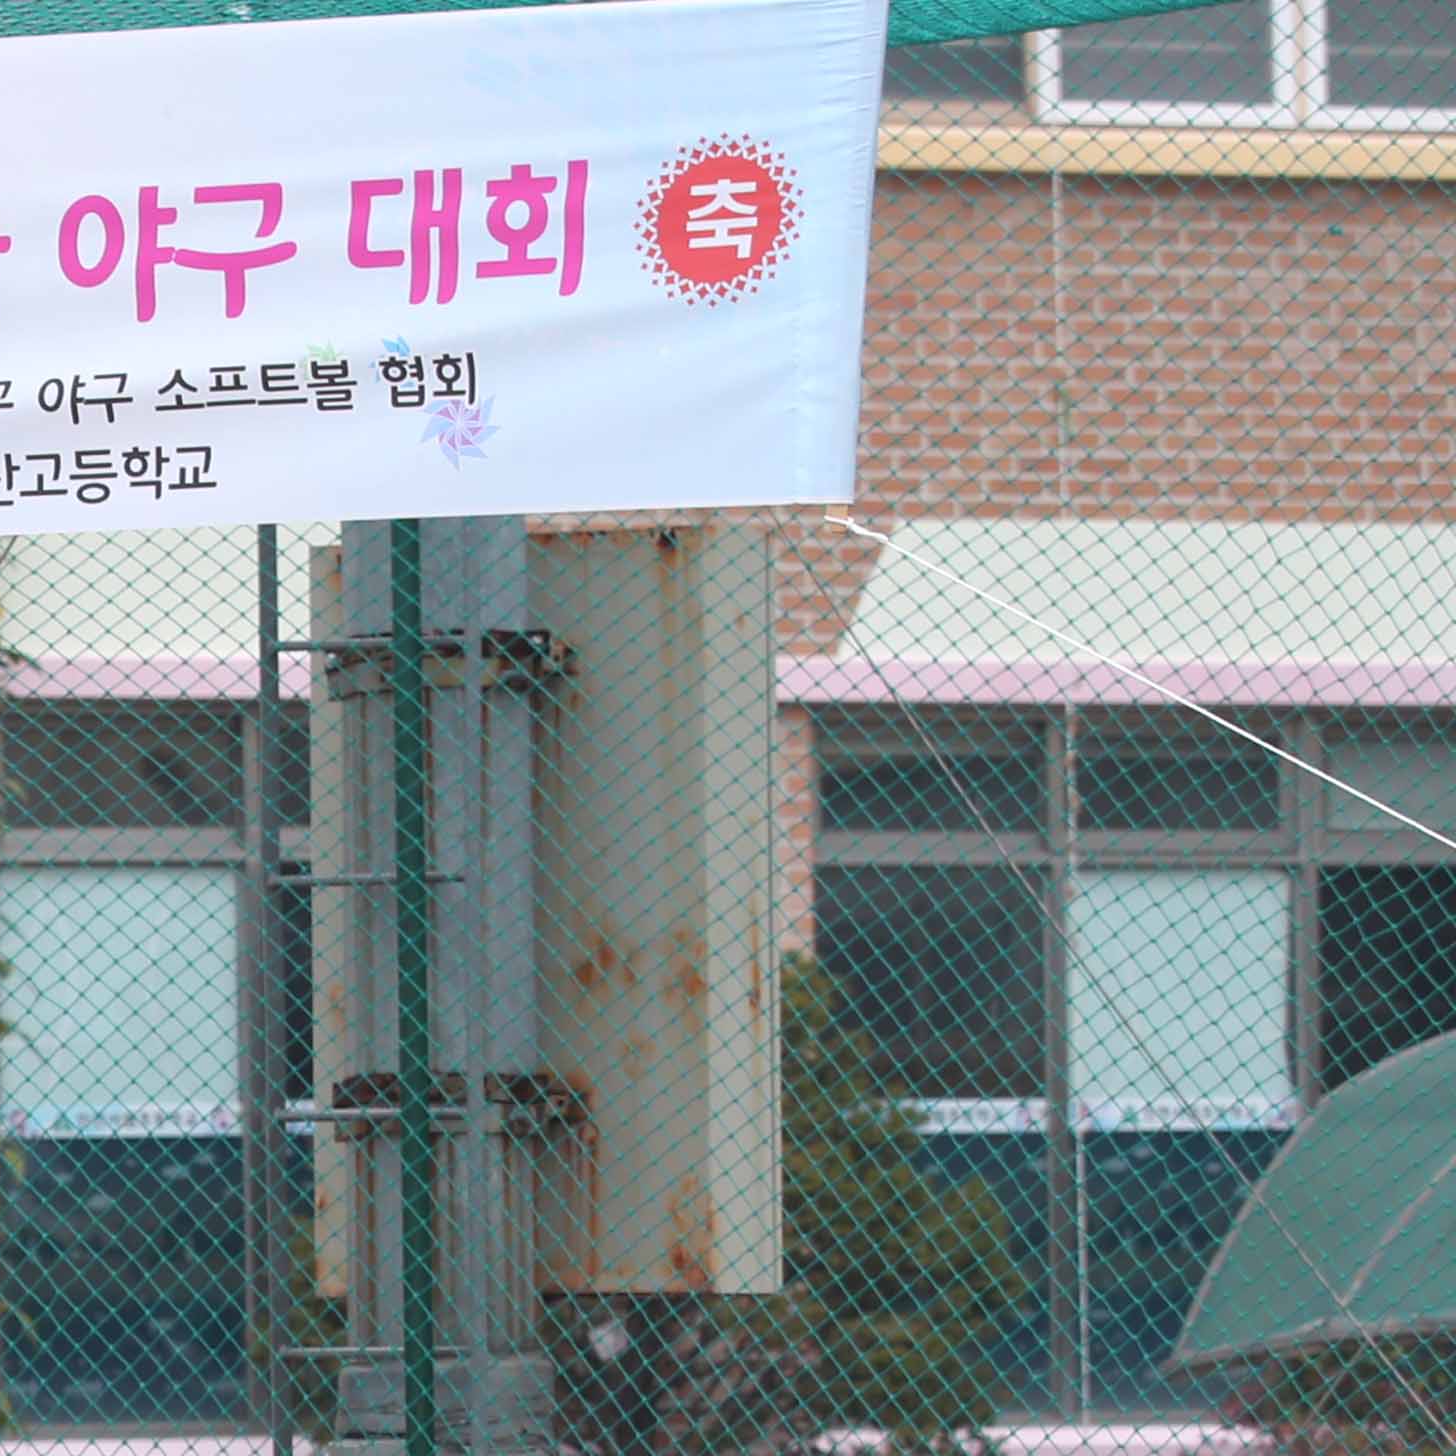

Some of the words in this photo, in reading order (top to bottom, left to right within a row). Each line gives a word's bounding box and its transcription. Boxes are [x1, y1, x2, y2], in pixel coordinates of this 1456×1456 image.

[58, 181, 298, 323] 야구
[347, 159, 589, 305] 대회
[686, 178, 758, 259] 축
[38, 372, 134, 425] 야구
[154, 359, 358, 412] 소프트볼
[378, 350, 478, 408] 협회
